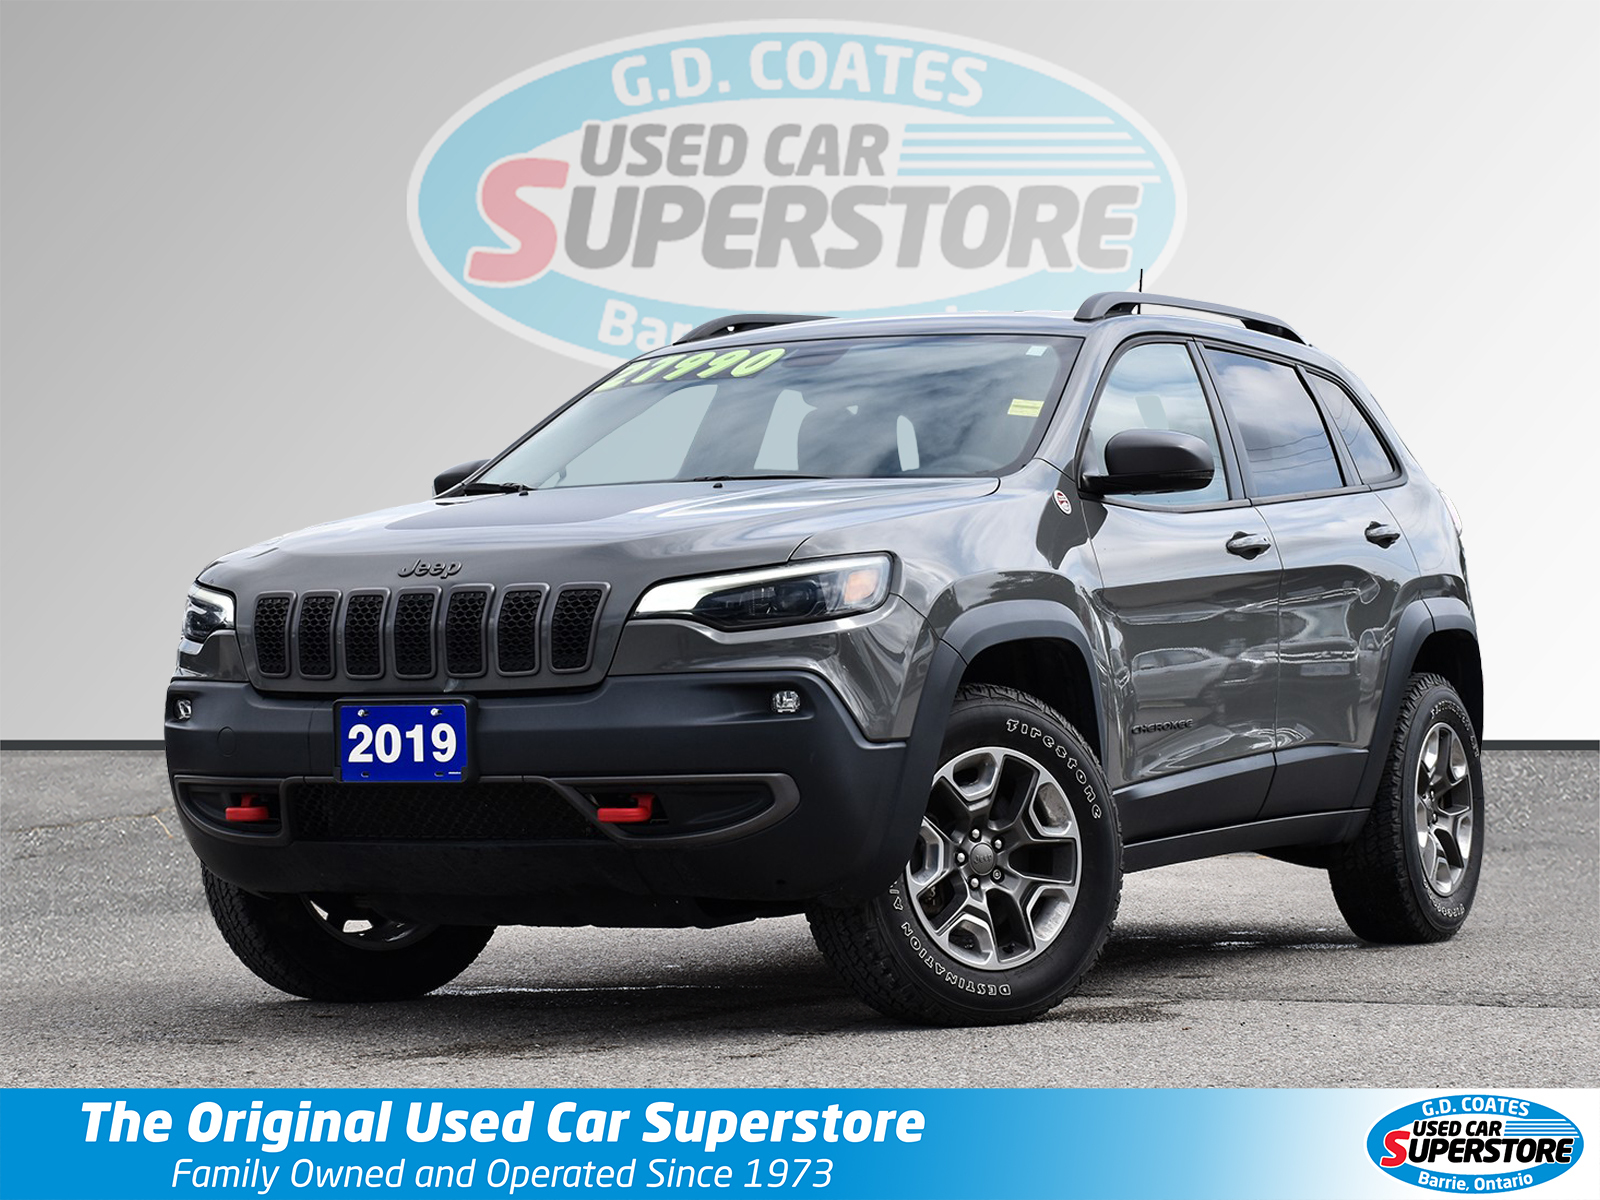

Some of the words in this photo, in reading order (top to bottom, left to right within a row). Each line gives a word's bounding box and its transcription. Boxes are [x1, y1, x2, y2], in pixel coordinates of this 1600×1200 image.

[397, 558, 463, 579] Jeep
[348, 723, 457, 763] 2019
[1131, 718, 1193, 734] CHEROKEE
[1006, 718, 1102, 819] Firestone
[901, 922, 1012, 996] DESTINATION
